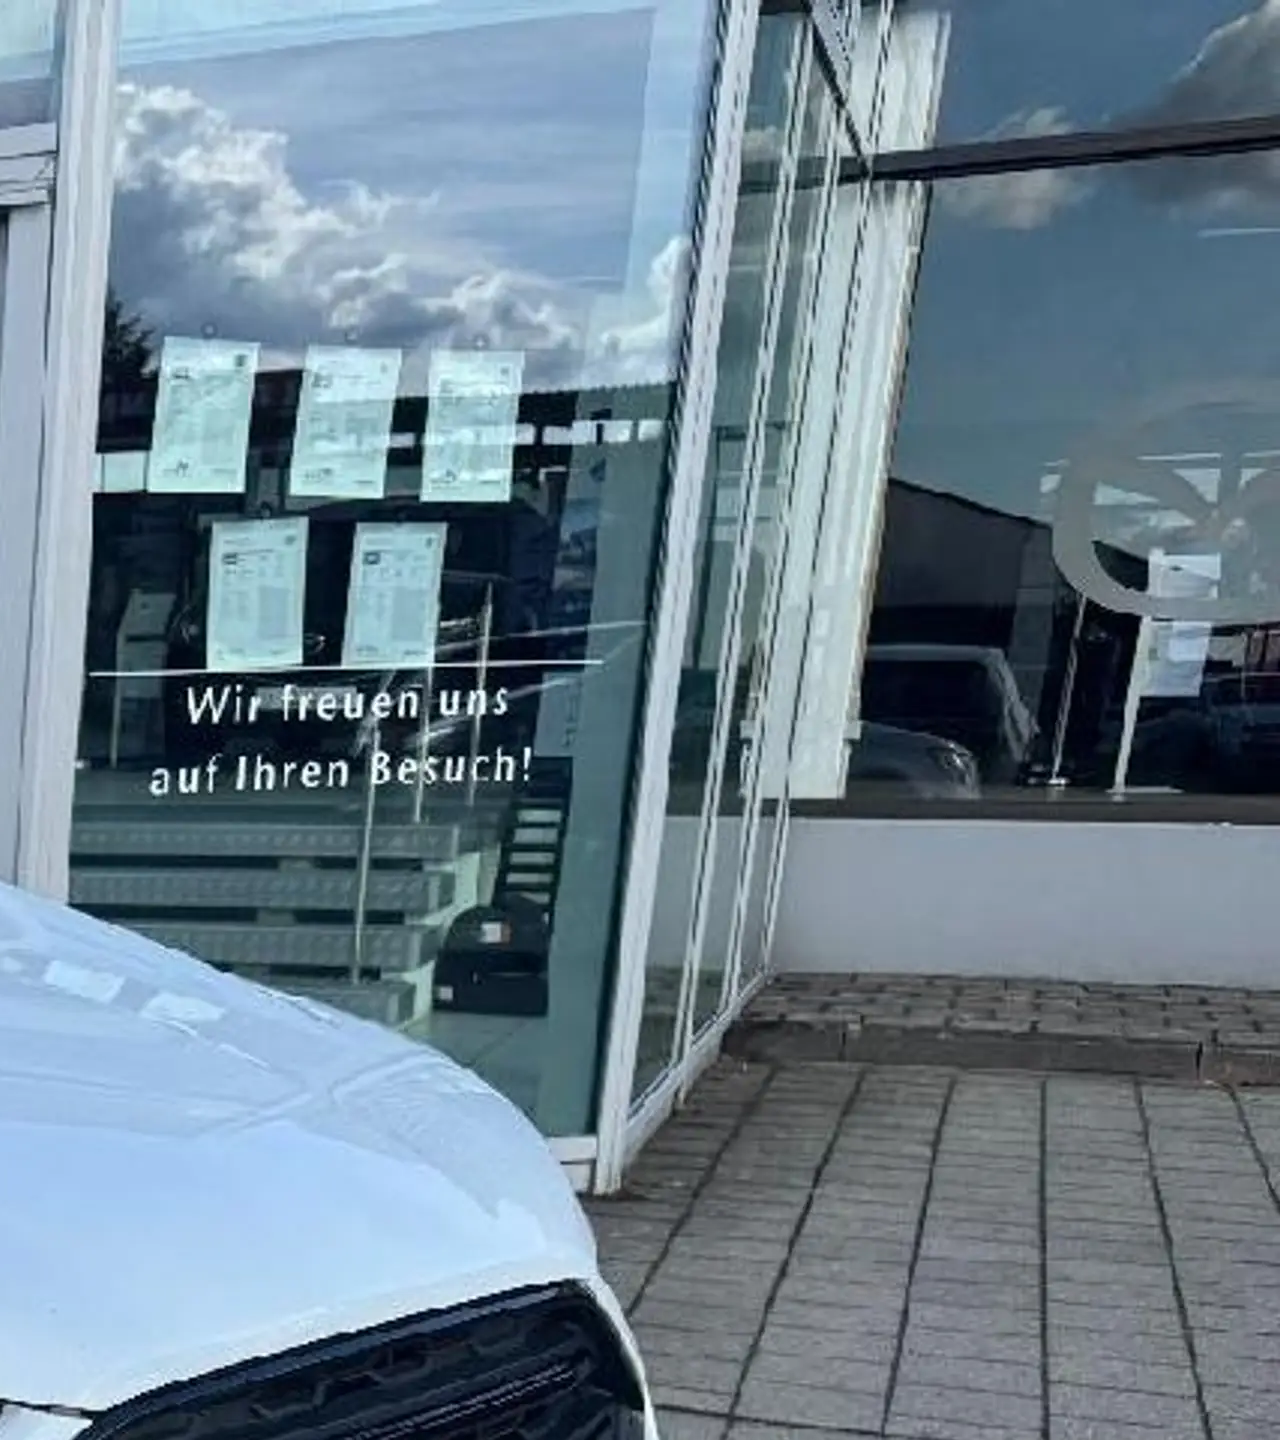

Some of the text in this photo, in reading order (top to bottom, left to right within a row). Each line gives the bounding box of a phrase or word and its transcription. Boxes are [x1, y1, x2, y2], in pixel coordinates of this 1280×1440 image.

[186, 684, 509, 725] Wir freuen uns
[148, 746, 533, 797] auf Ihren Besuch!
